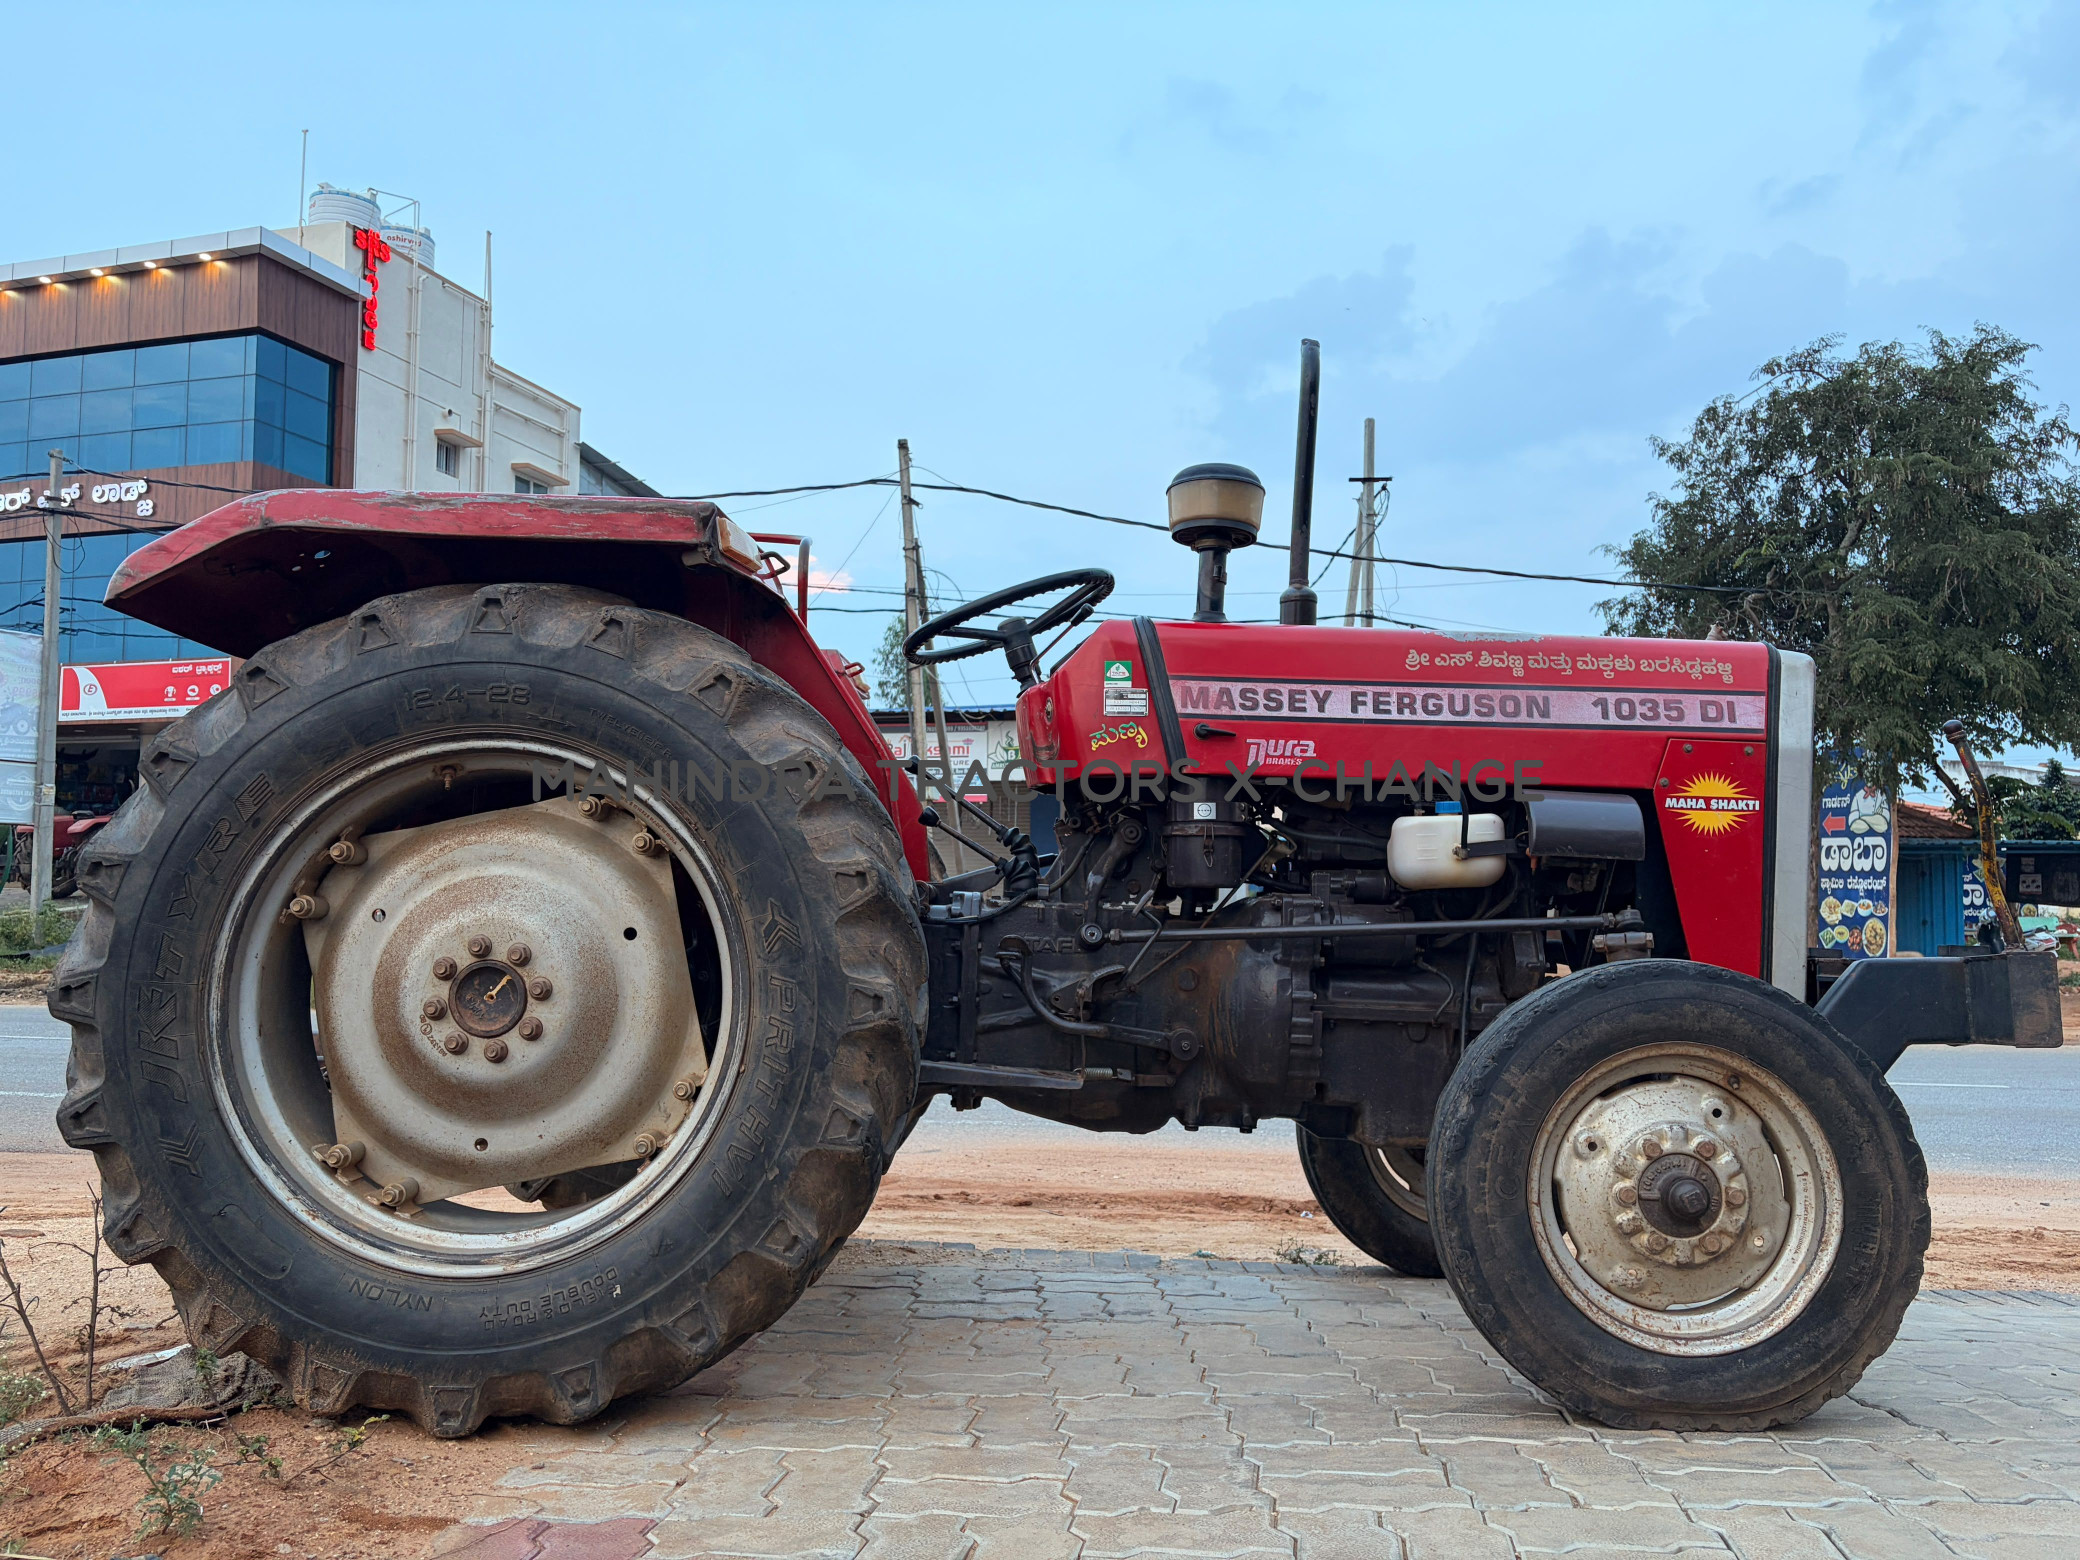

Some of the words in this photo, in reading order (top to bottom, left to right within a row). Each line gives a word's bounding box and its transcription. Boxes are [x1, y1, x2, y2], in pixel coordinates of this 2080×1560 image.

[1405, 649, 1430, 671] ಶ್ರೀ
[1527, 652, 1573, 676] ಮತ್ತು
[1576, 653, 1636, 679] ಮಕ್ಕಳು
[1180, 685, 1333, 714] MASSEY
[1350, 689, 1552, 720] FERGUSON
[1591, 696, 1686, 723] 1035
[1699, 699, 1738, 725] DI
[1266, 757, 1303, 766] BRAKES
[1664, 797, 1707, 809] MAHA
[1709, 799, 1760, 811] SHAKTI
[154, 772, 275, 979] TYRE
[711, 975, 798, 1197] PRITHVI
[348, 1276, 433, 1311] NYLON
[538, 1267, 619, 1309] DOUBLE
[478, 1300, 532, 1319] DUTY
